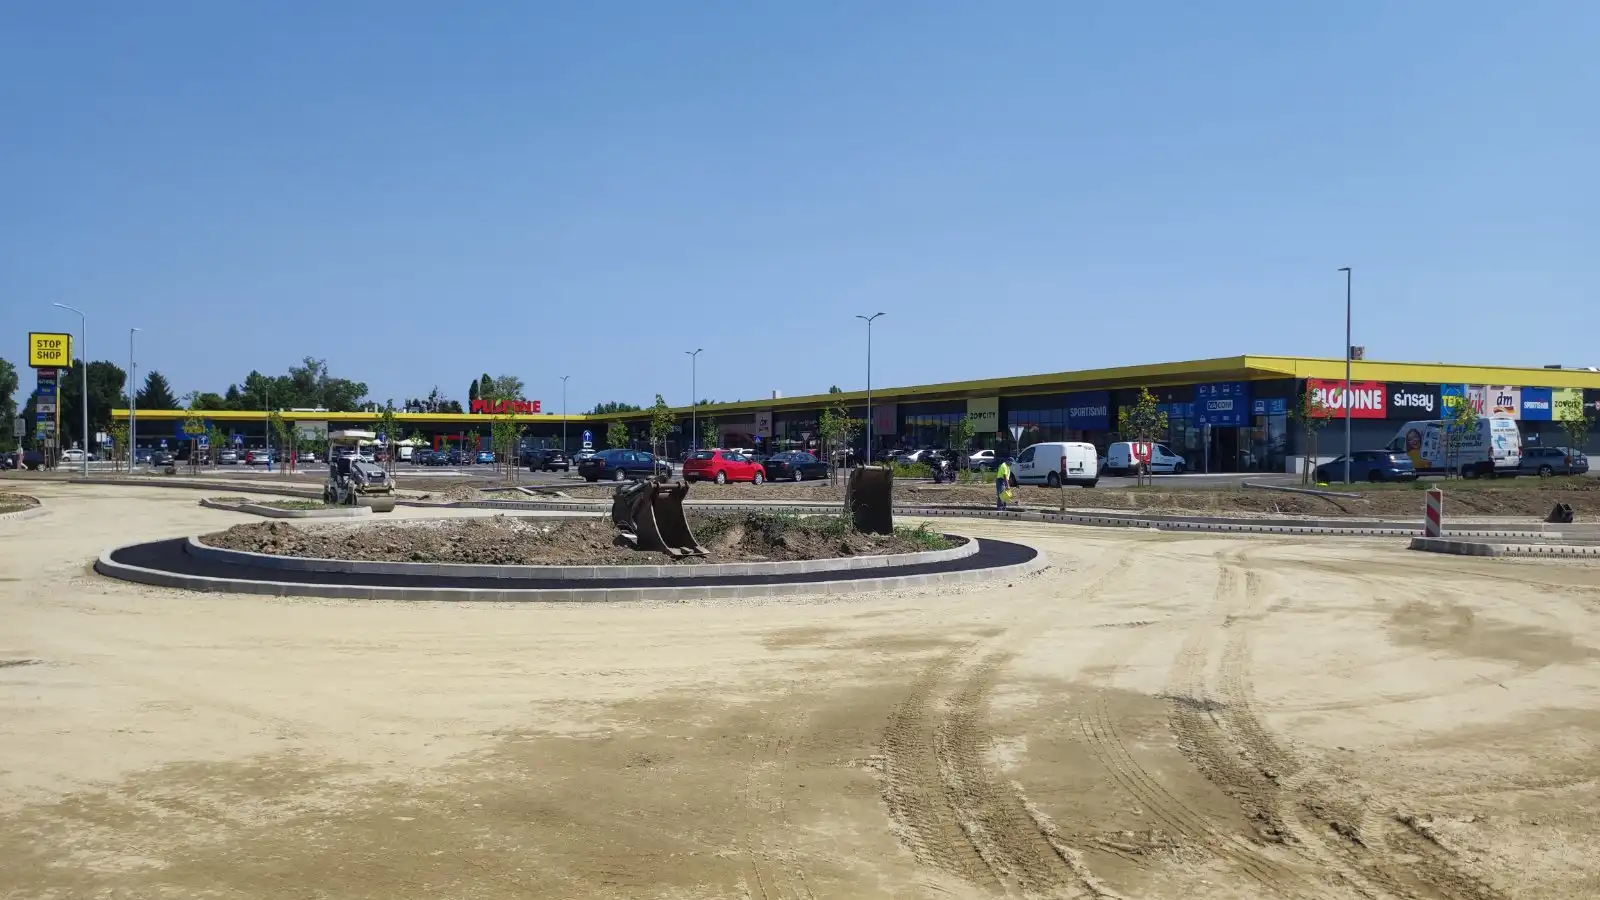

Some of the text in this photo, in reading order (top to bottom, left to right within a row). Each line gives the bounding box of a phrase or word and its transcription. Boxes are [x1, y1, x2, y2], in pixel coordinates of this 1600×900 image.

[37, 340, 61, 348] STOP
[37, 351, 61, 359] SHOP
[1394, 390, 1433, 411] sinsay
[1497, 392, 1512, 405] dm
